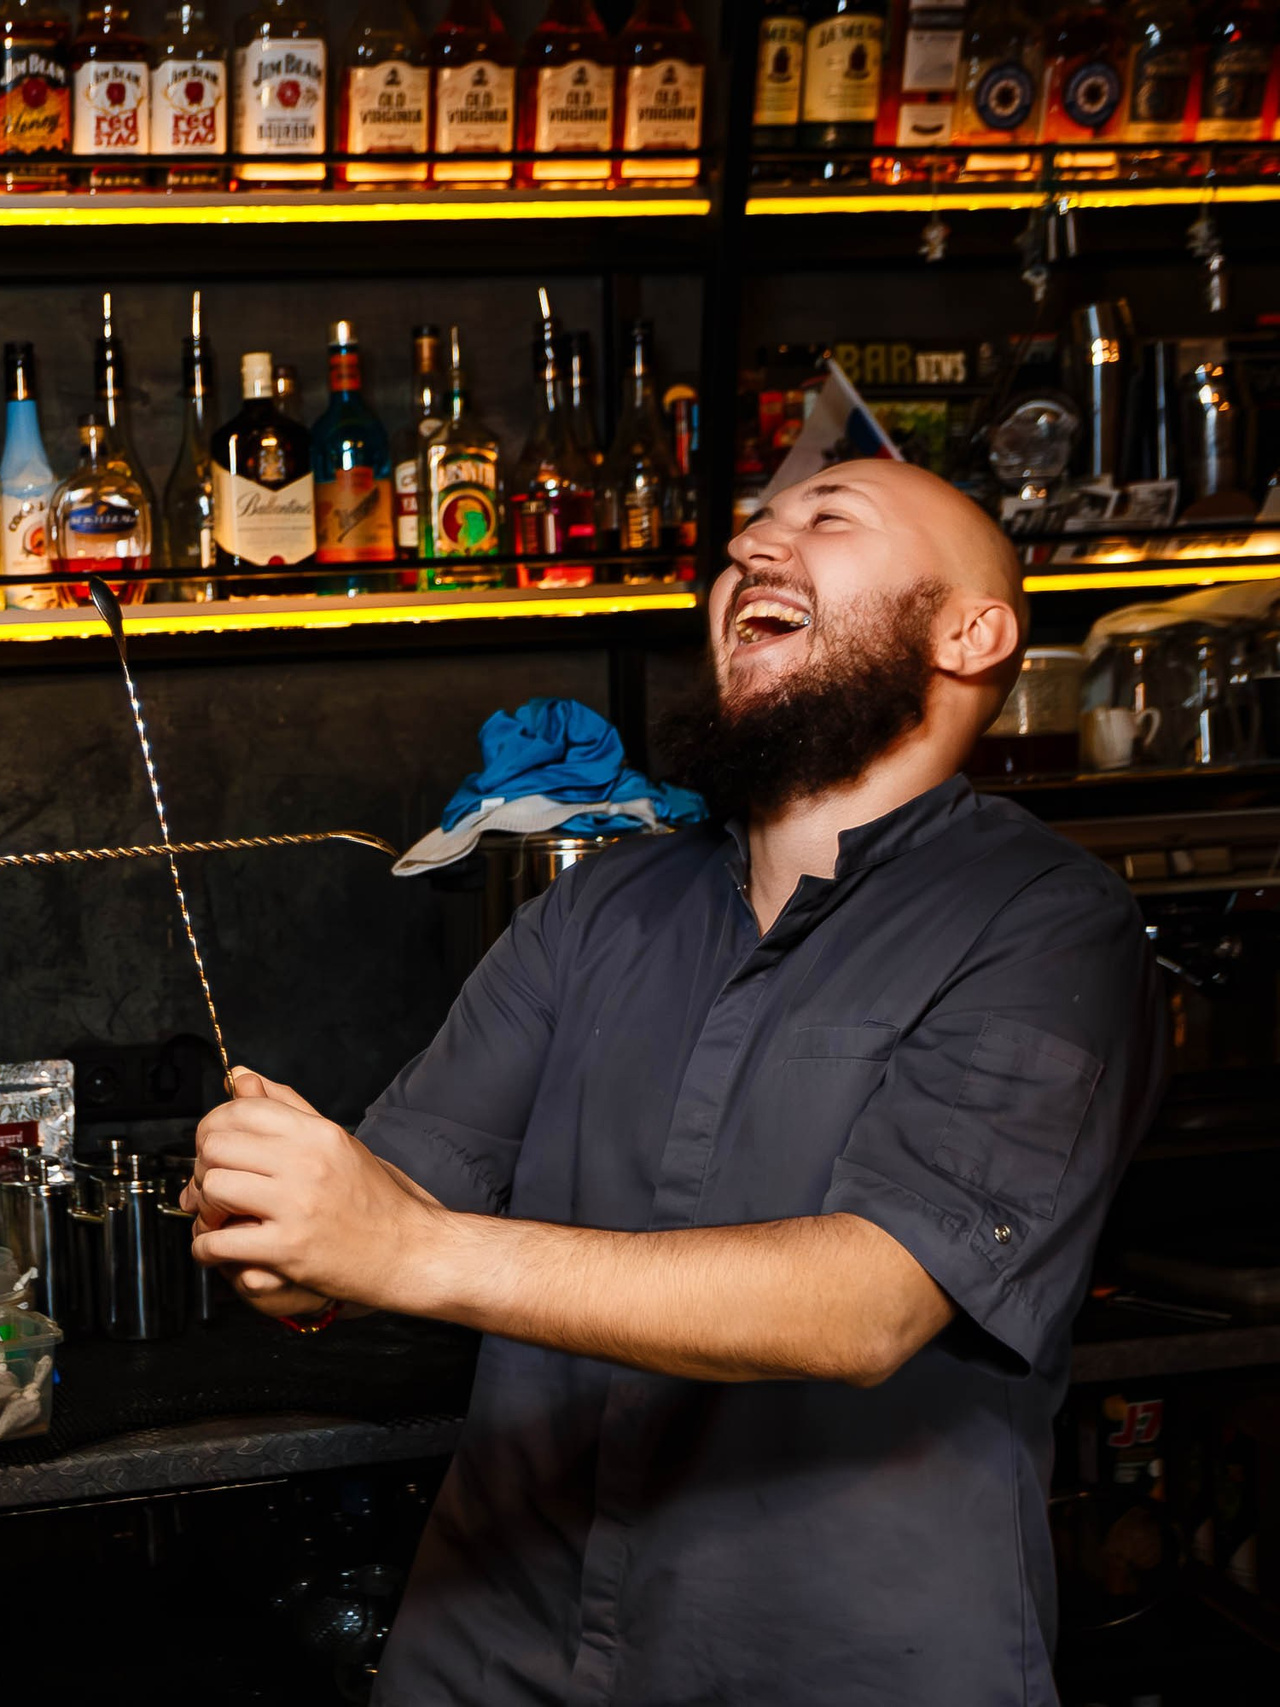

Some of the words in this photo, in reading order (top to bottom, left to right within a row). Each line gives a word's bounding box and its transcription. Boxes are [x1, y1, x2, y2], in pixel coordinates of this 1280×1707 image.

[28, 52, 66, 84] BEAM
[252, 60, 283, 88] JIM
[284, 52, 322, 82] BEAM
[95, 108, 138, 132] red
[173, 108, 215, 131] red
[94, 132, 138, 146] STAG
[172, 131, 216, 146] STAG
[834, 341, 913, 384] BAR
[1105, 1398, 1166, 1449] J7
